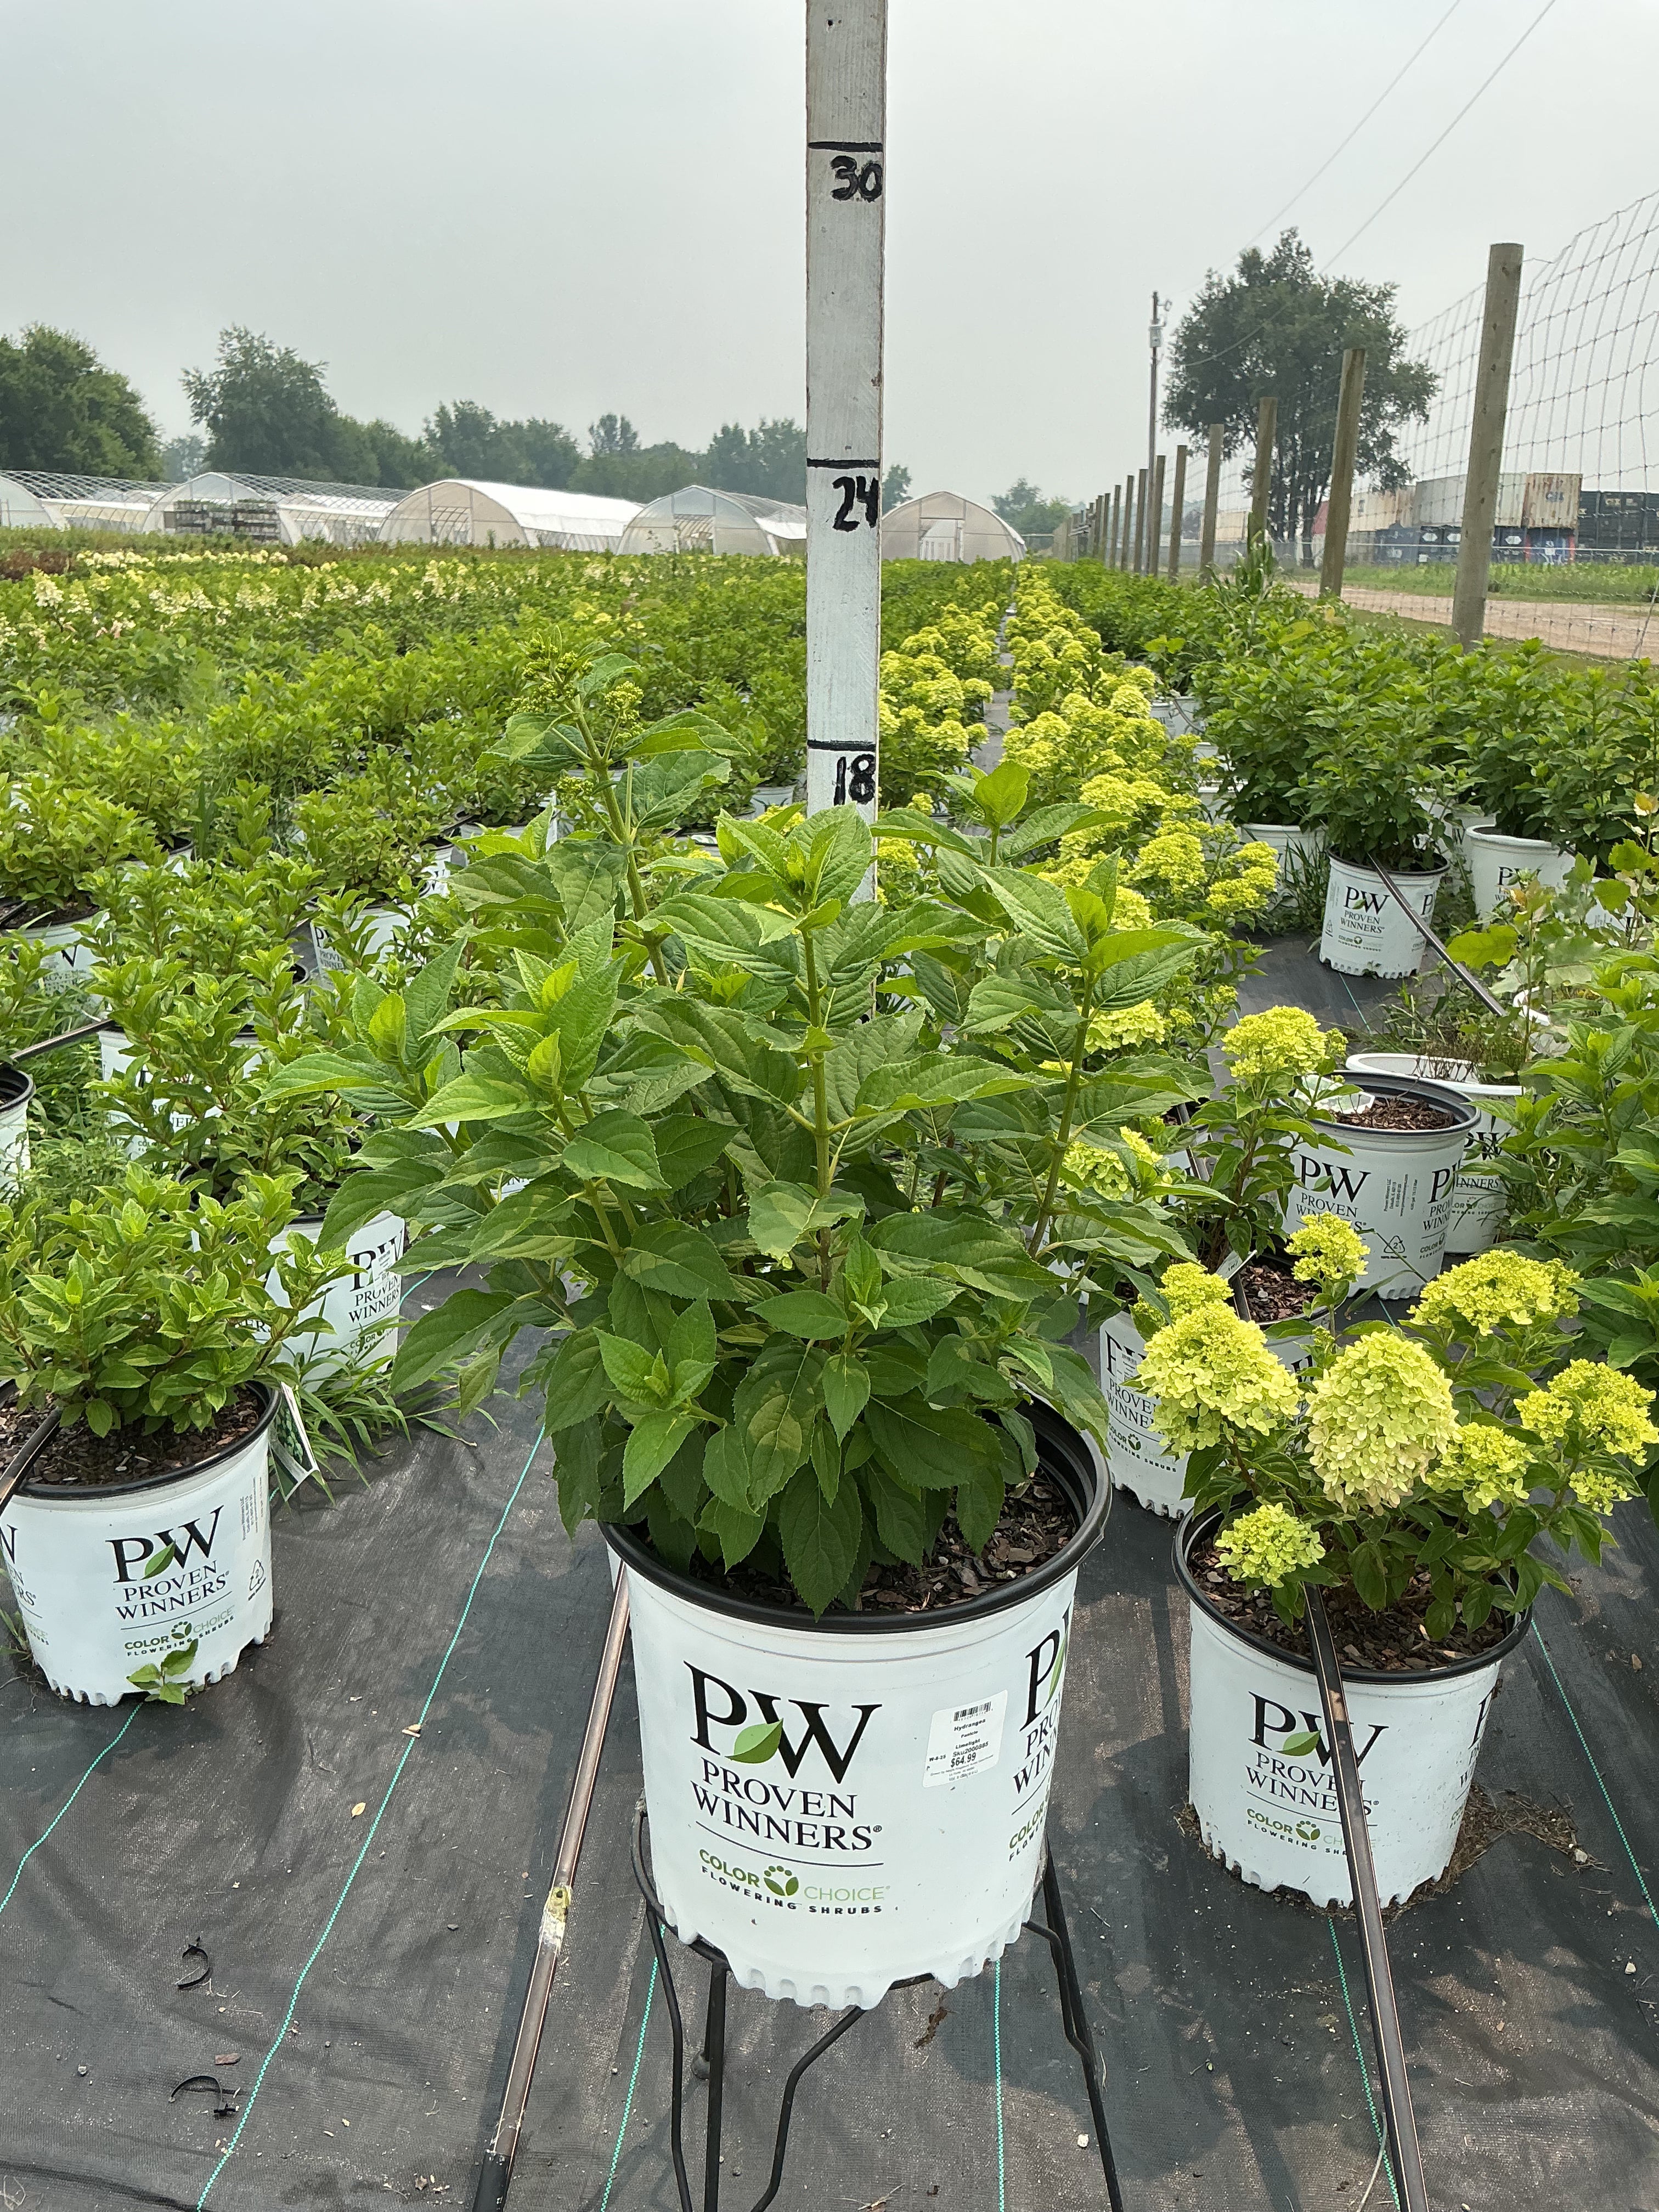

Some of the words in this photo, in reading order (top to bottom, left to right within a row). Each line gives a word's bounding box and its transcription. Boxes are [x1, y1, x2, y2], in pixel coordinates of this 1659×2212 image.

[830, 155, 883, 202] 30
[832, 476, 878, 533] 24
[833, 754, 876, 806] 18
[1343, 885, 1390, 915] PW
[1344, 910, 1380, 925] PROVEN
[1340, 917, 1383, 934] WINNERS
[1299, 1154, 1371, 1203] PW
[1455, 1177, 1501, 1190] INNERS
[1301, 1192, 1358, 1217] PROVEN
[105, 1505, 224, 1583] PW
[123, 1560, 217, 1602] PROVEN
[125, 1635, 169, 1649] COLOR
[193, 1607, 233, 1633] CHOICE
[127, 1638, 193, 1656] FLOWERING
[199, 1616, 234, 1638] SHRUBS
[684, 1662, 882, 1785] PW
[954, 1718, 986, 1731] Hydrangea
[950, 1752, 977, 1768] $64.99
[956, 1739, 980, 1750] Limelight
[701, 1757, 858, 1819] PROVEN
[1247, 1808, 1293, 1835] COLOR
[1248, 1819, 1317, 1850] FLOWERING
[699, 1849, 760, 1888] COLOR
[804, 1886, 885, 1901] CHOICE
[702, 1866, 797, 1910] FLOWERING
[809, 1905, 882, 1915] SHRUBS
